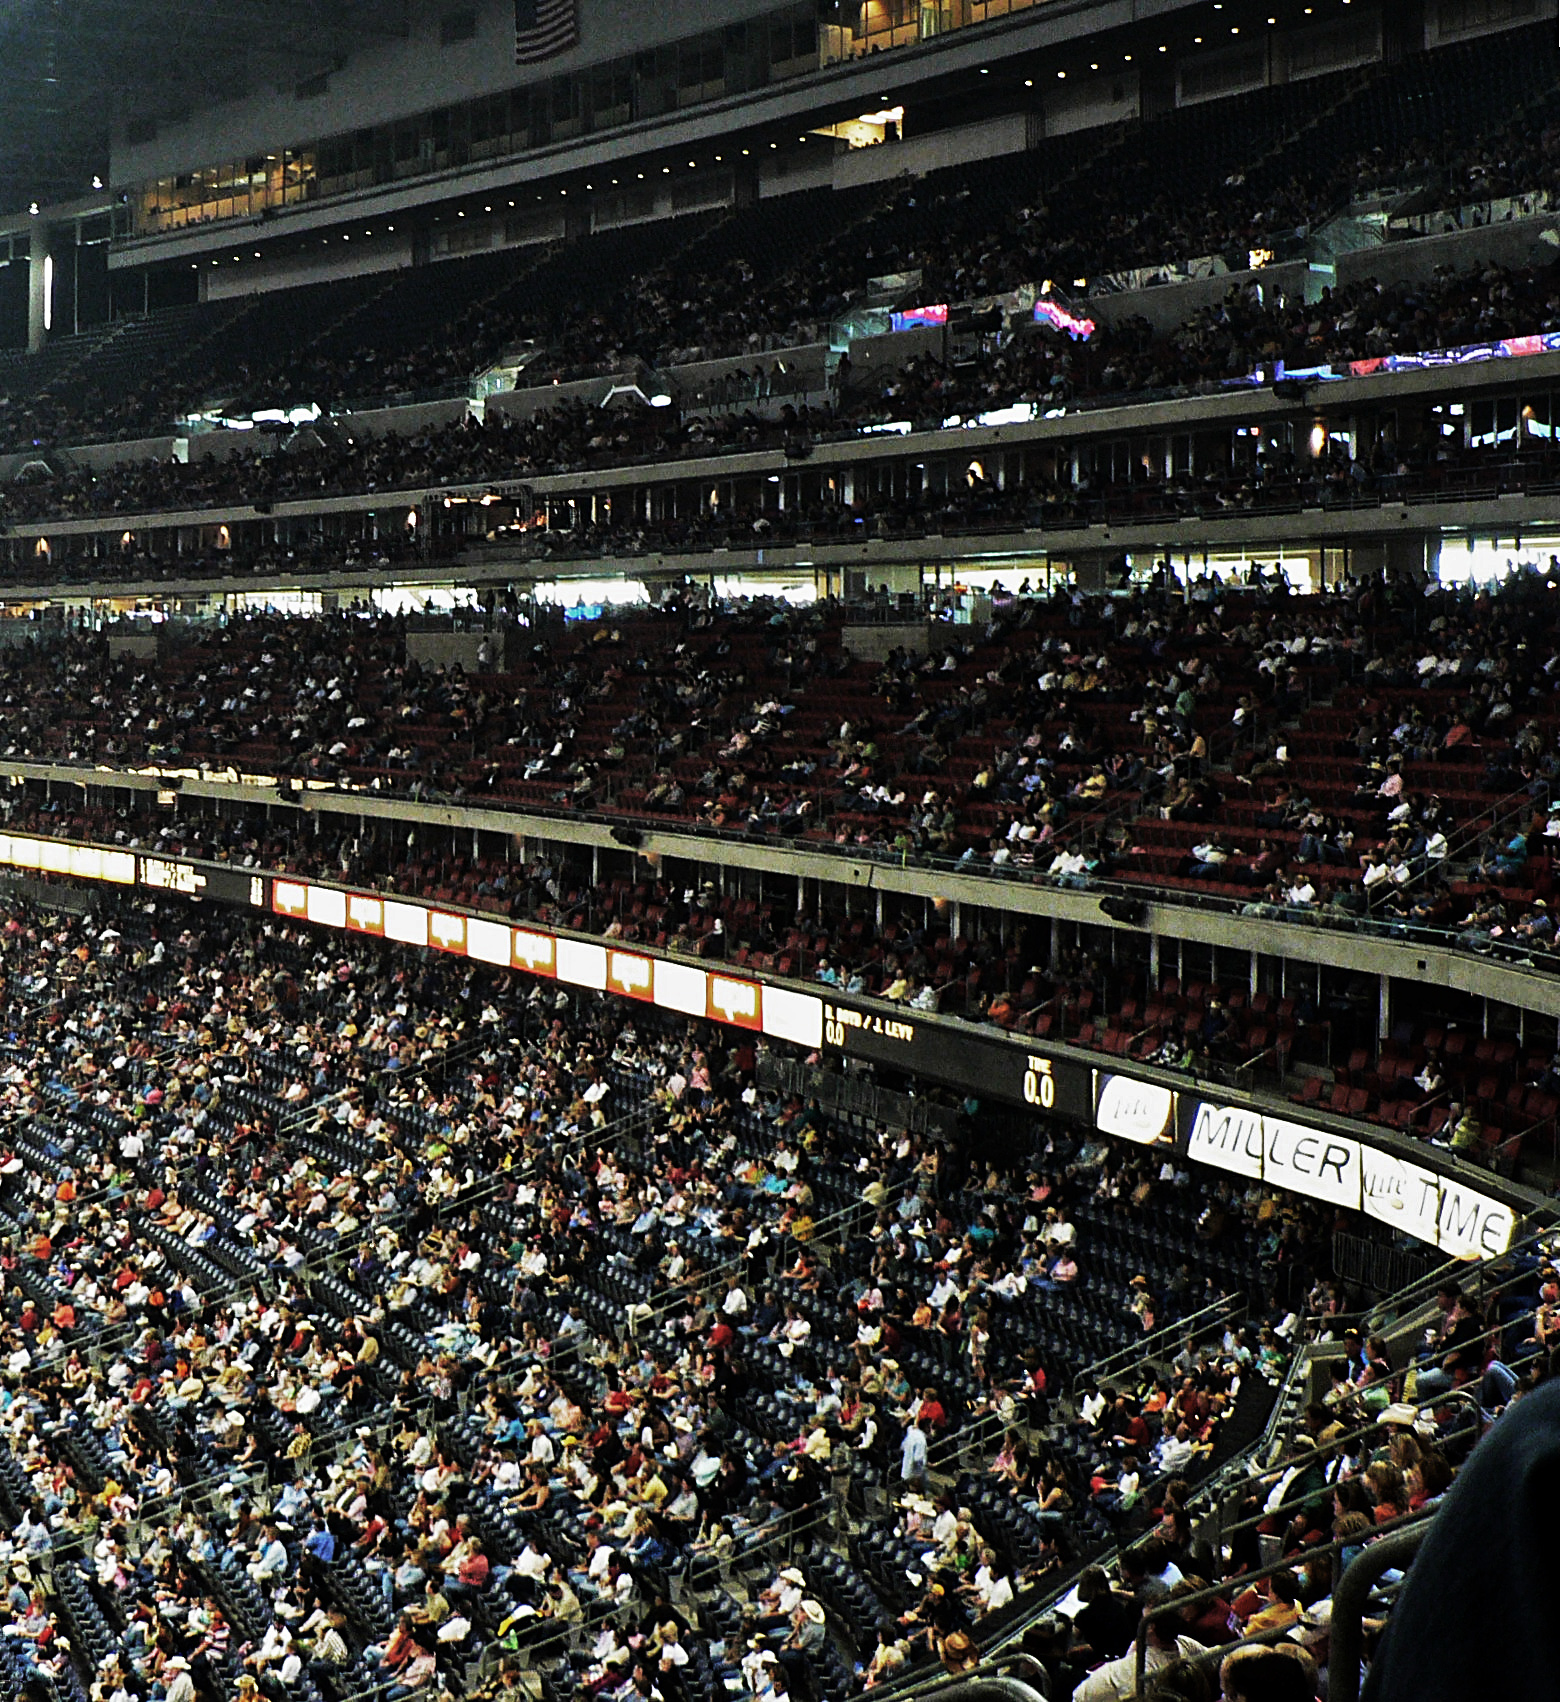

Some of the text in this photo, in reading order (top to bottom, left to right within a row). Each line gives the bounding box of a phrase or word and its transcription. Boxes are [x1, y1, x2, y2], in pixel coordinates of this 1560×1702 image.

[825, 1022, 845, 1047] 0.0
[1023, 1070, 1055, 1108] 0.0
[1195, 1109, 1351, 1184] MILLER
[1419, 1176, 1506, 1255] TIME
